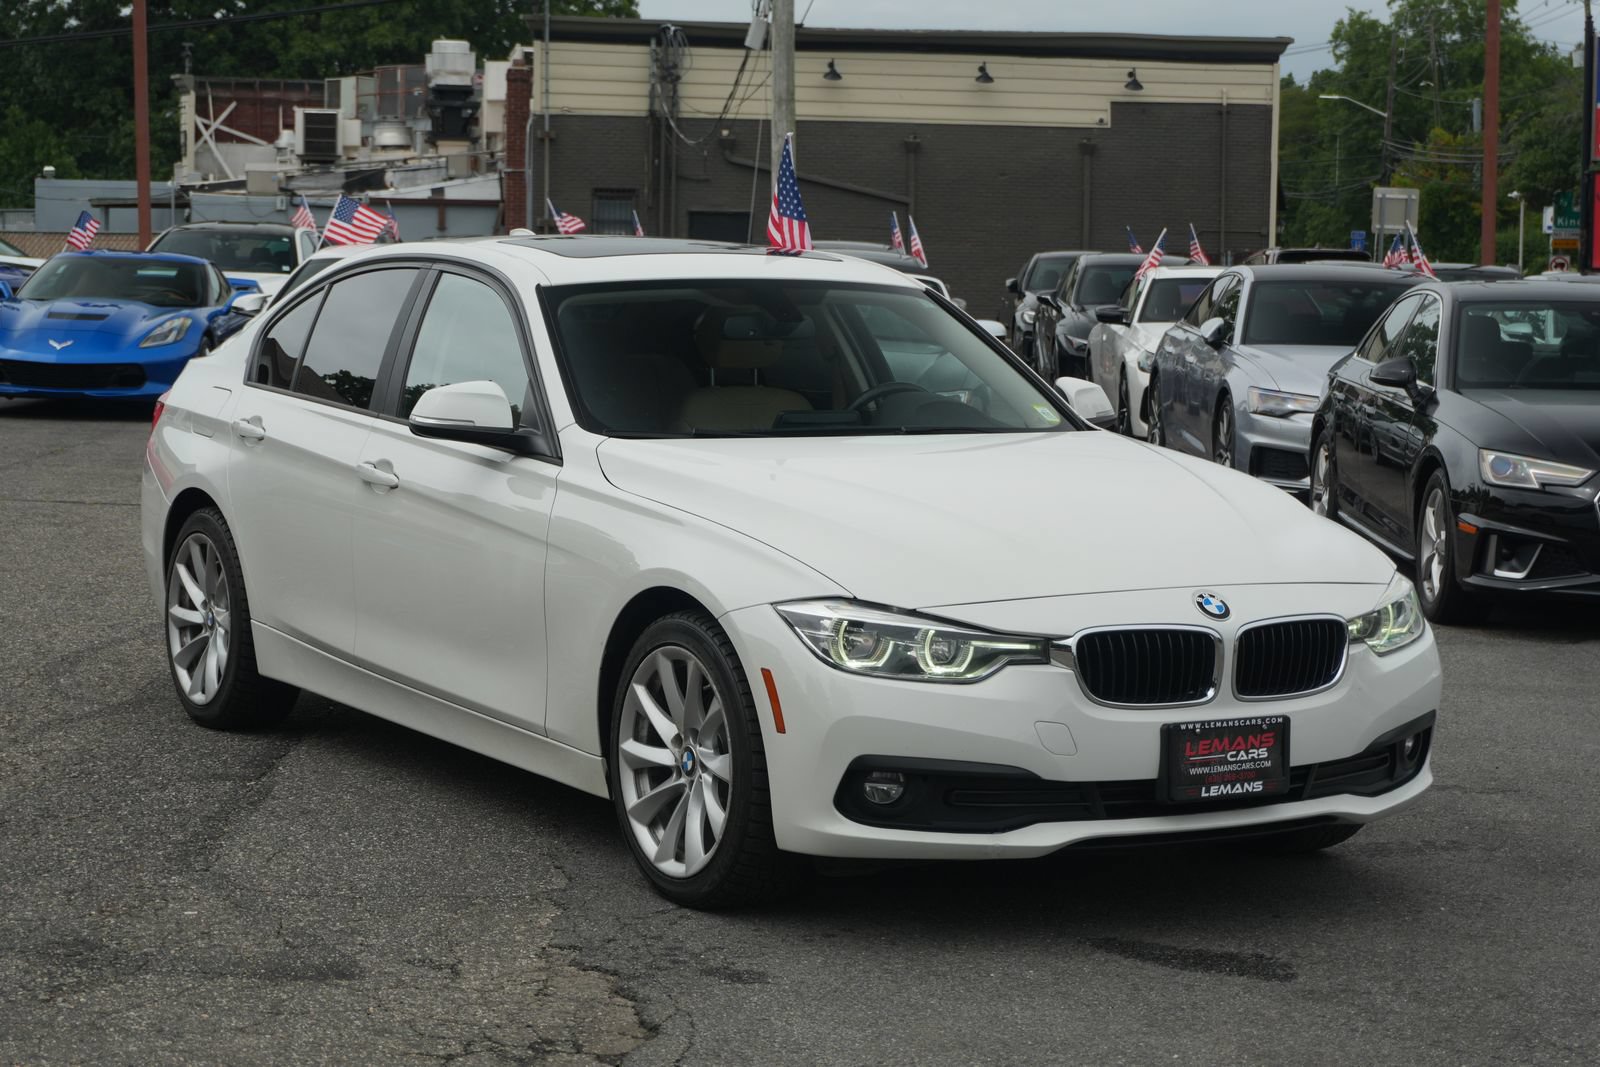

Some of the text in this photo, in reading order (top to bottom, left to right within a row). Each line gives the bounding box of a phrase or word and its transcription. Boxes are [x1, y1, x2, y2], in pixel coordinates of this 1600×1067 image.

[1180, 717, 1283, 730] WWW.LEMANSCARS.COM
[1184, 732, 1276, 756] LEMANS
[1226, 748, 1269, 762] CARS
[1189, 760, 1272, 775] WWW.LEMANSCARS.COM
[1201, 781, 1264, 797] LEMANS
